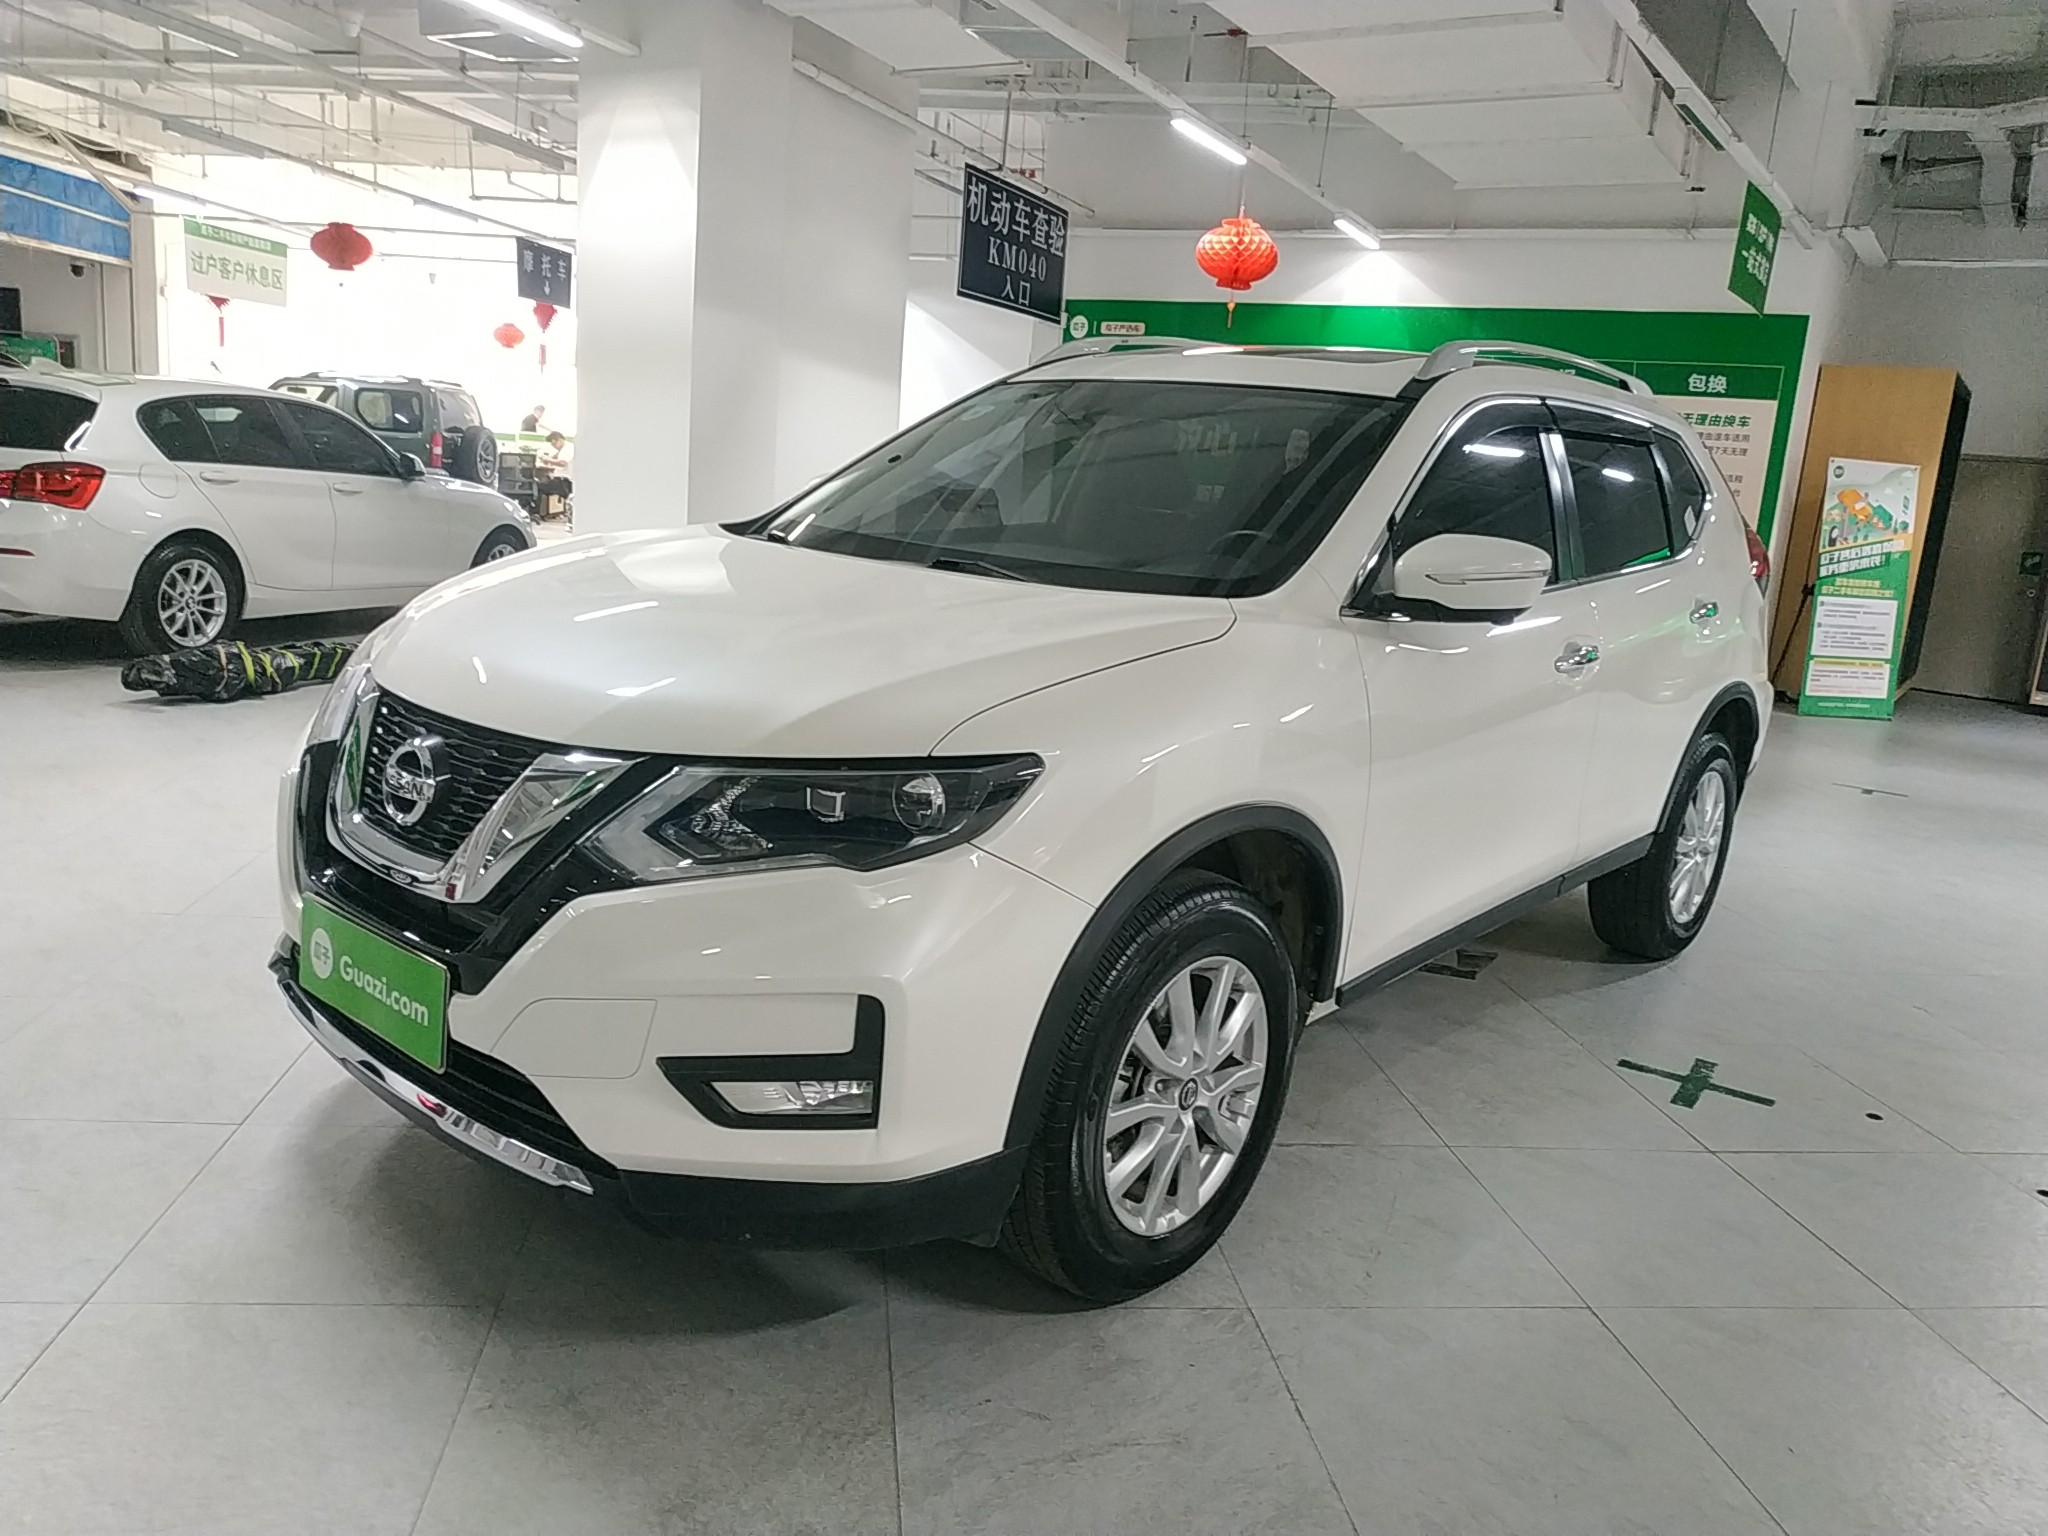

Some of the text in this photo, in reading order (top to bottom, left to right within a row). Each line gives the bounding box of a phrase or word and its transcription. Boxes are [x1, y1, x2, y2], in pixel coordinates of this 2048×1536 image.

[967, 176, 1065, 258] 机动车查验
[190, 249, 284, 291] 过户客户休息区
[987, 236, 1047, 282] KM040
[1001, 275, 1031, 307] 入口
[1687, 373, 1728, 394] 包换
[1679, 412, 1752, 428] 无理由换车
[340, 955, 428, 1027] Guazi.com
